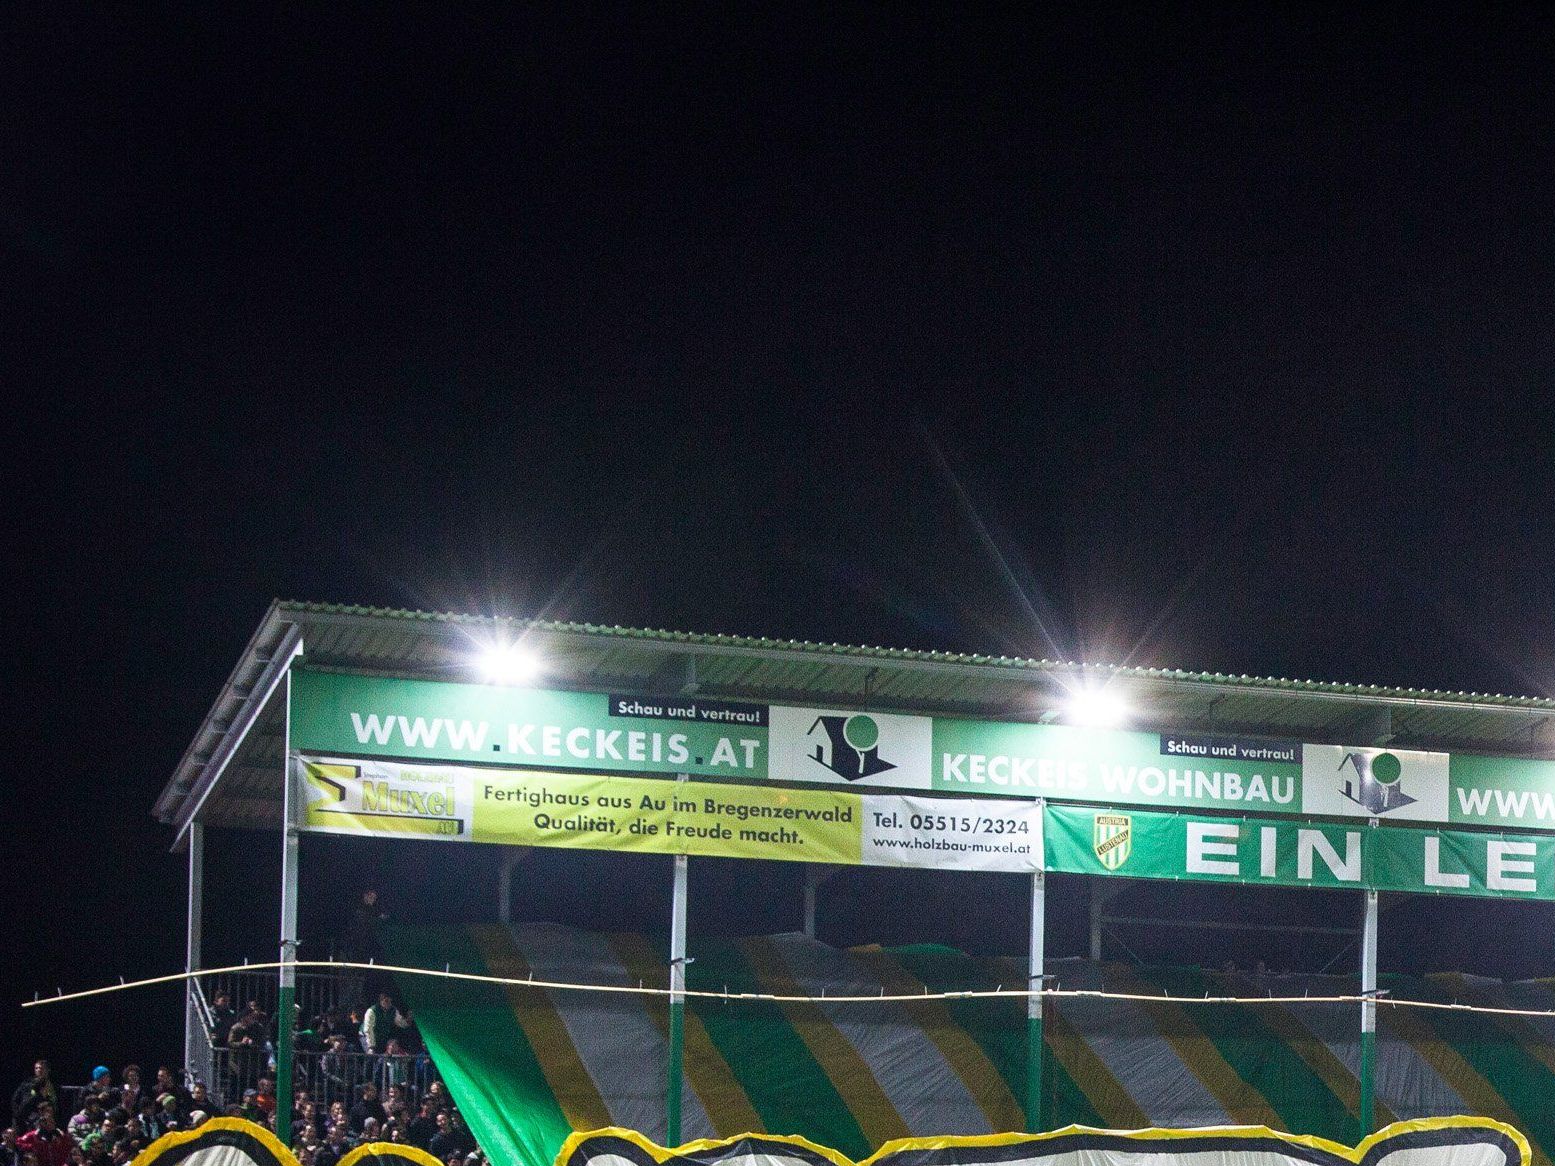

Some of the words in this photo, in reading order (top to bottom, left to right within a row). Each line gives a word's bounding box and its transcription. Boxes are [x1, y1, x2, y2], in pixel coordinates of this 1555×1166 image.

[618, 701, 665, 717] Schau
[668, 703, 697, 719] und
[700, 706, 761, 723] vertrau!
[1167, 739, 1208, 755] Schau
[1211, 742, 1238, 758] und
[1241, 744, 1295, 761] vertrau!
[942, 753, 1088, 790] KECKEIS
[1101, 764, 1295, 804] WOHNBAU
[362, 780, 456, 817] Muxel
[484, 784, 589, 809] Fertighaus
[597, 793, 632, 811] aus
[639, 792, 667, 812] Au
[673, 795, 697, 814] im
[704, 798, 853, 824] Bregenzerwald
[534, 812, 622, 836] Qualität,
[629, 816, 659, 836] die
[666, 819, 733, 840] Freude
[739, 824, 804, 845] macht.
[874, 812, 904, 830] Tel.
[910, 813, 1030, 835] 05515/2324
[873, 835, 1031, 855] www.holzbau-muxel.at
[1186, 822, 1361, 881] EIN
